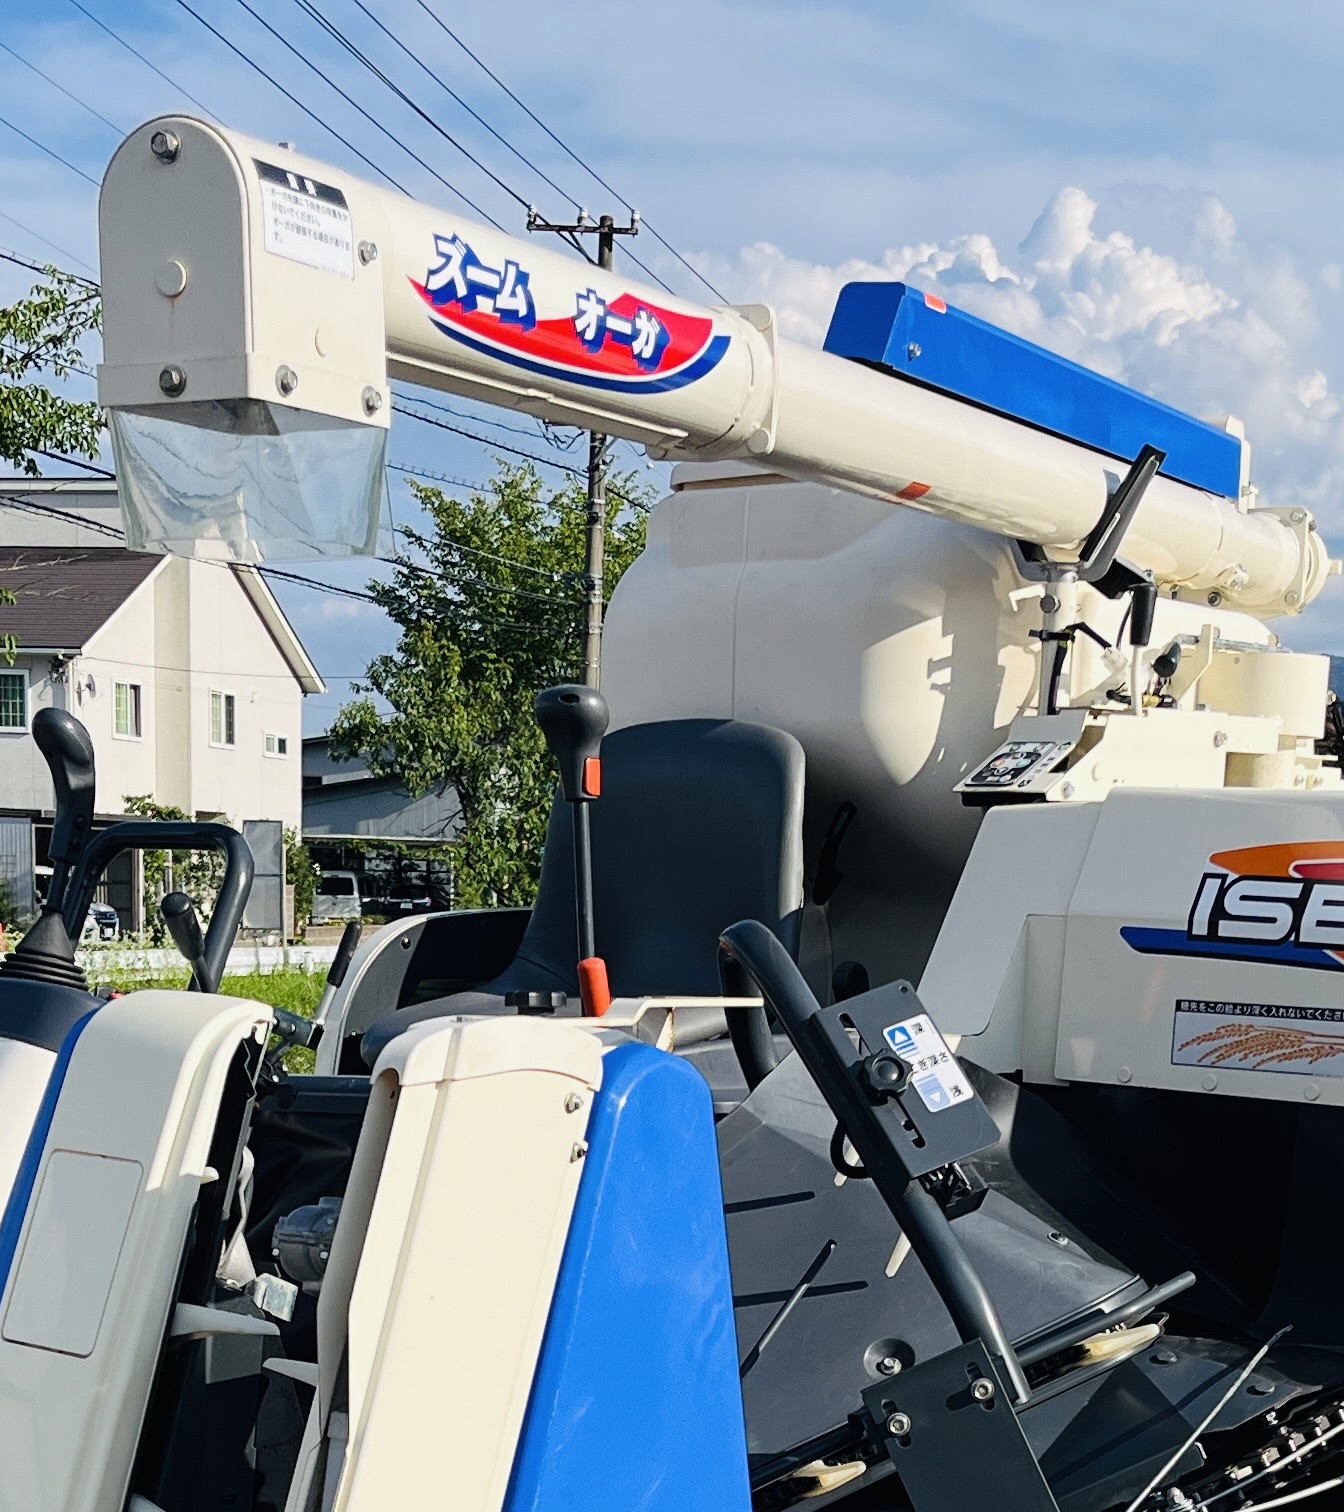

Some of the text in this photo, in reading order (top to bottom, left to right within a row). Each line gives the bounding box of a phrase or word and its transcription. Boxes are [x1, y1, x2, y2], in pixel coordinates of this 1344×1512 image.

[425, 233, 670, 371] ズーム オーガ
